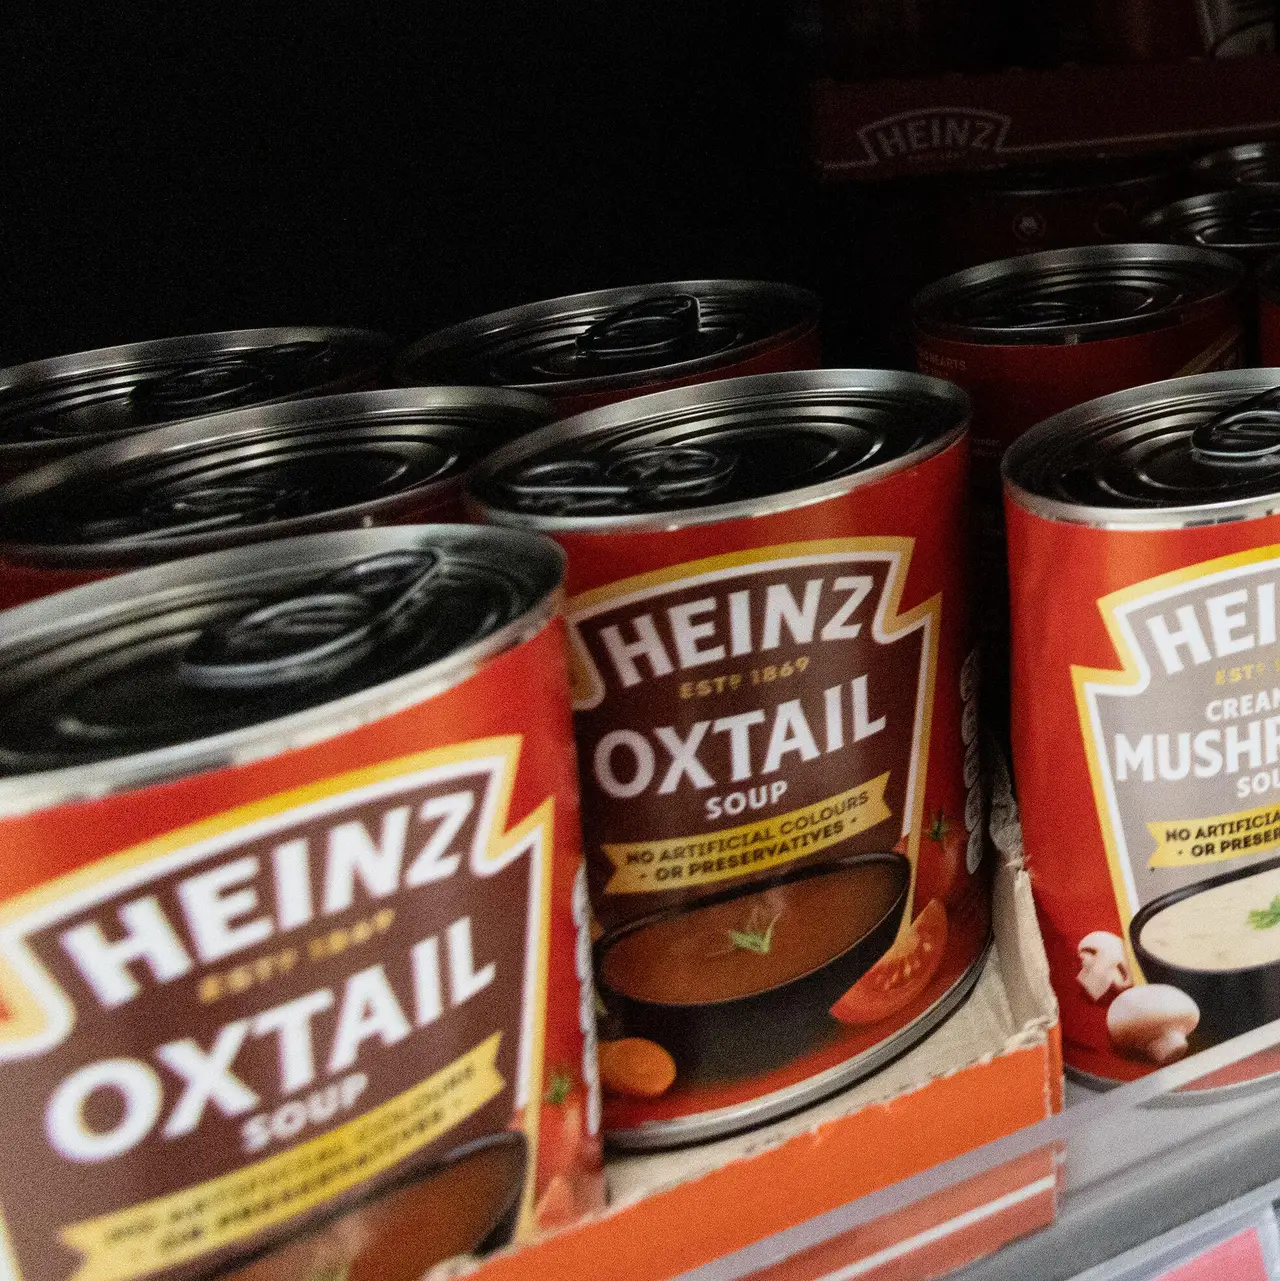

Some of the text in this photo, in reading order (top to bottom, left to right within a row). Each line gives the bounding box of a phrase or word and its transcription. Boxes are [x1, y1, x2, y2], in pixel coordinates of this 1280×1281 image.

[877, 118, 995, 155] HEINZ
[603, 575, 876, 688] HEINZ
[751, 656, 810, 688] 1869
[594, 675, 887, 799] OXTAIL
[625, 791, 870, 866] NO ARTIFICIAL COLOURS
[705, 779, 789, 821] SOUP
[655, 823, 844, 885] OR PRESERVATIVES
[1165, 827, 1191, 843] NO
[1190, 840, 1216, 858] OR
[61, 791, 476, 1009] HEINZ
[46, 917, 497, 1163] OXTAIL
[240, 1071, 368, 1154] SOUP
